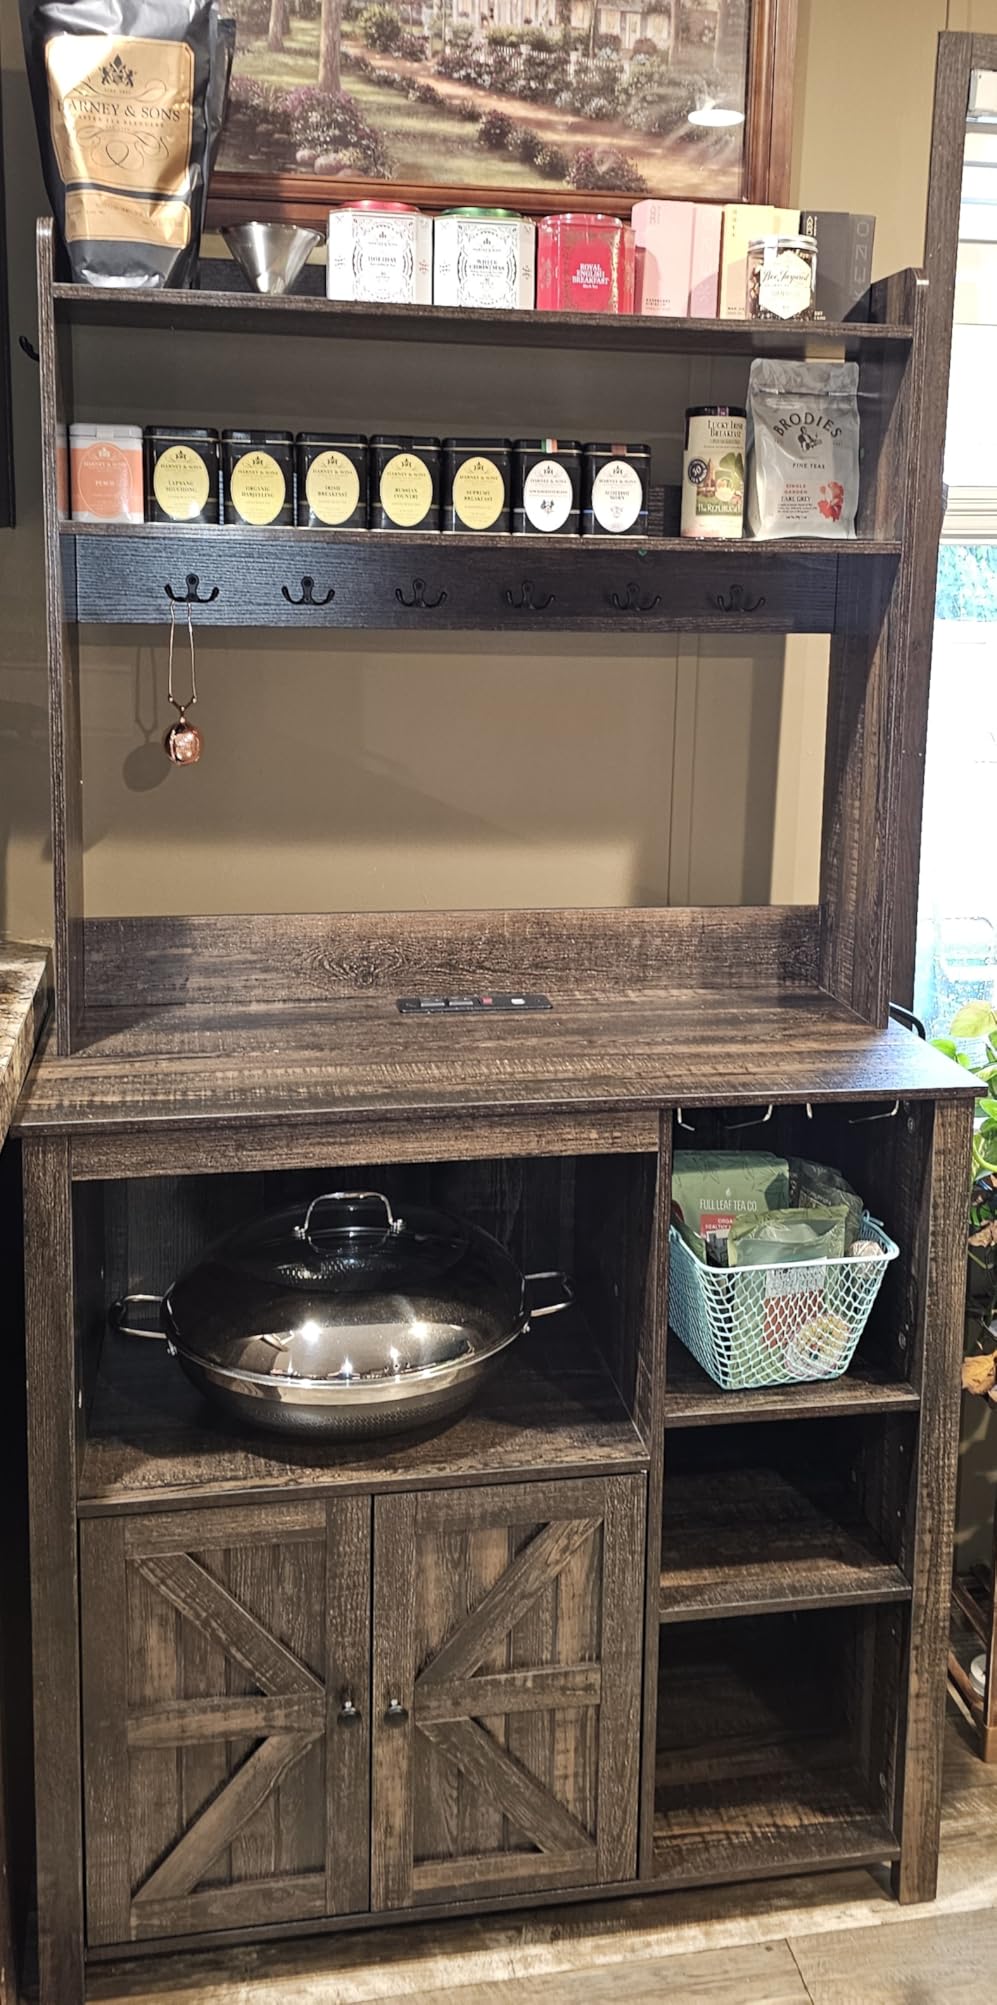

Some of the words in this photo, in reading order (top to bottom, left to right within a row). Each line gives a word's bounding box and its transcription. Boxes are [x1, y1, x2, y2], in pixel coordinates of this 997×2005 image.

[124, 105, 136, 117] &
[141, 107, 181, 122] SONS
[579, 263, 601, 271] ROYAL
[576, 269, 605, 278] ENGLISH
[572, 276, 610, 285] BREAKFAST
[707, 419, 728, 430] LUCKY
[773, 412, 842, 438] BRODIES
[692, 465, 702, 476] 50
[699, 1199, 715, 1210] FULL
[716, 1199, 732, 1210] LEAF
[733, 1200, 746, 1211] TEA
